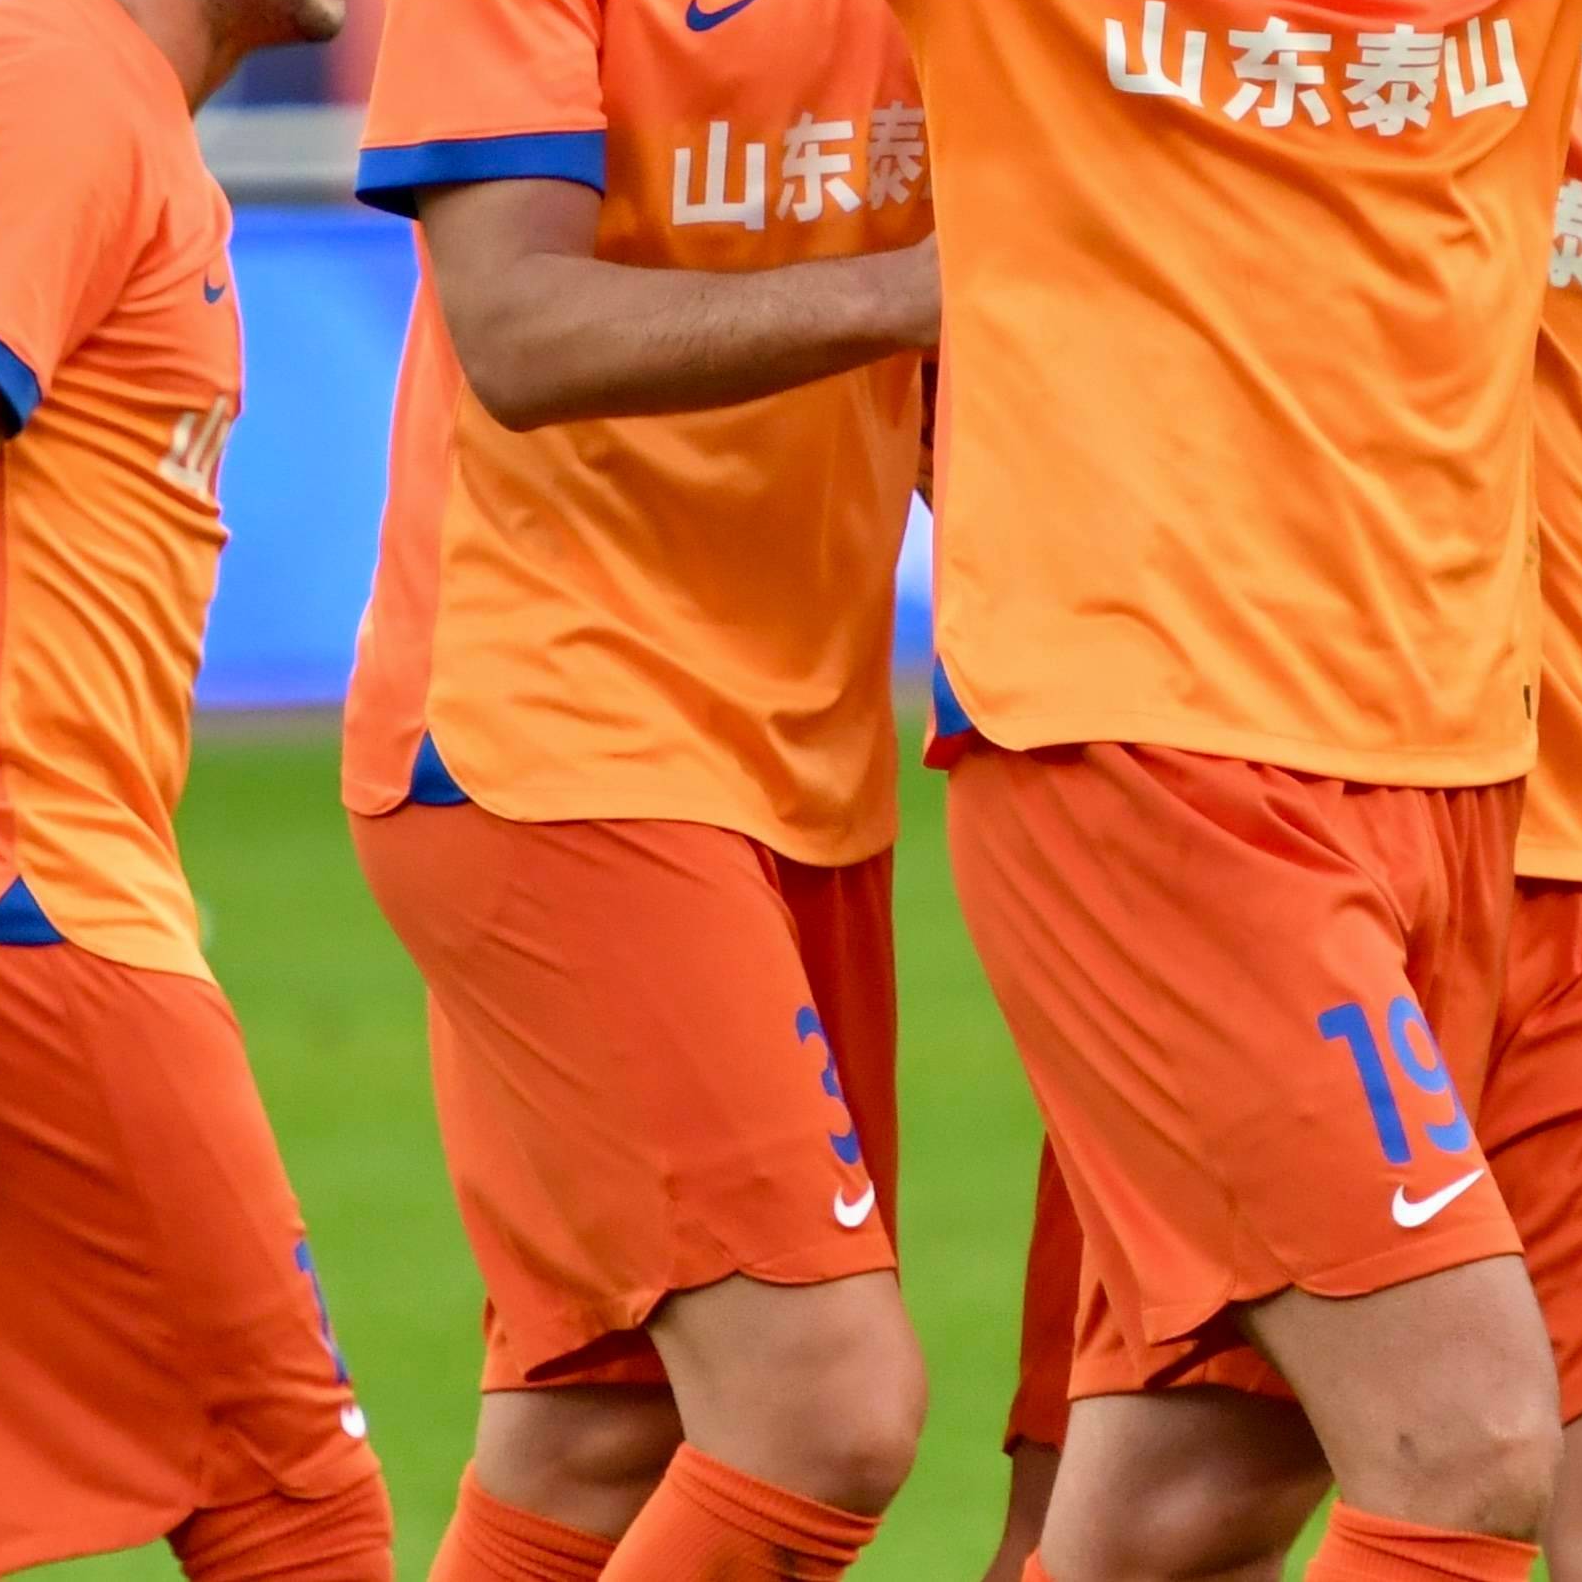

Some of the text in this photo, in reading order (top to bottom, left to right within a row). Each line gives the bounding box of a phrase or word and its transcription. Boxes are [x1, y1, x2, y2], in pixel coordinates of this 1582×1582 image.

[1105, 0, 1527, 137] 山东泰山
[671, 100, 932, 230] 山东泰
[1317, 995, 1472, 1165] 19
